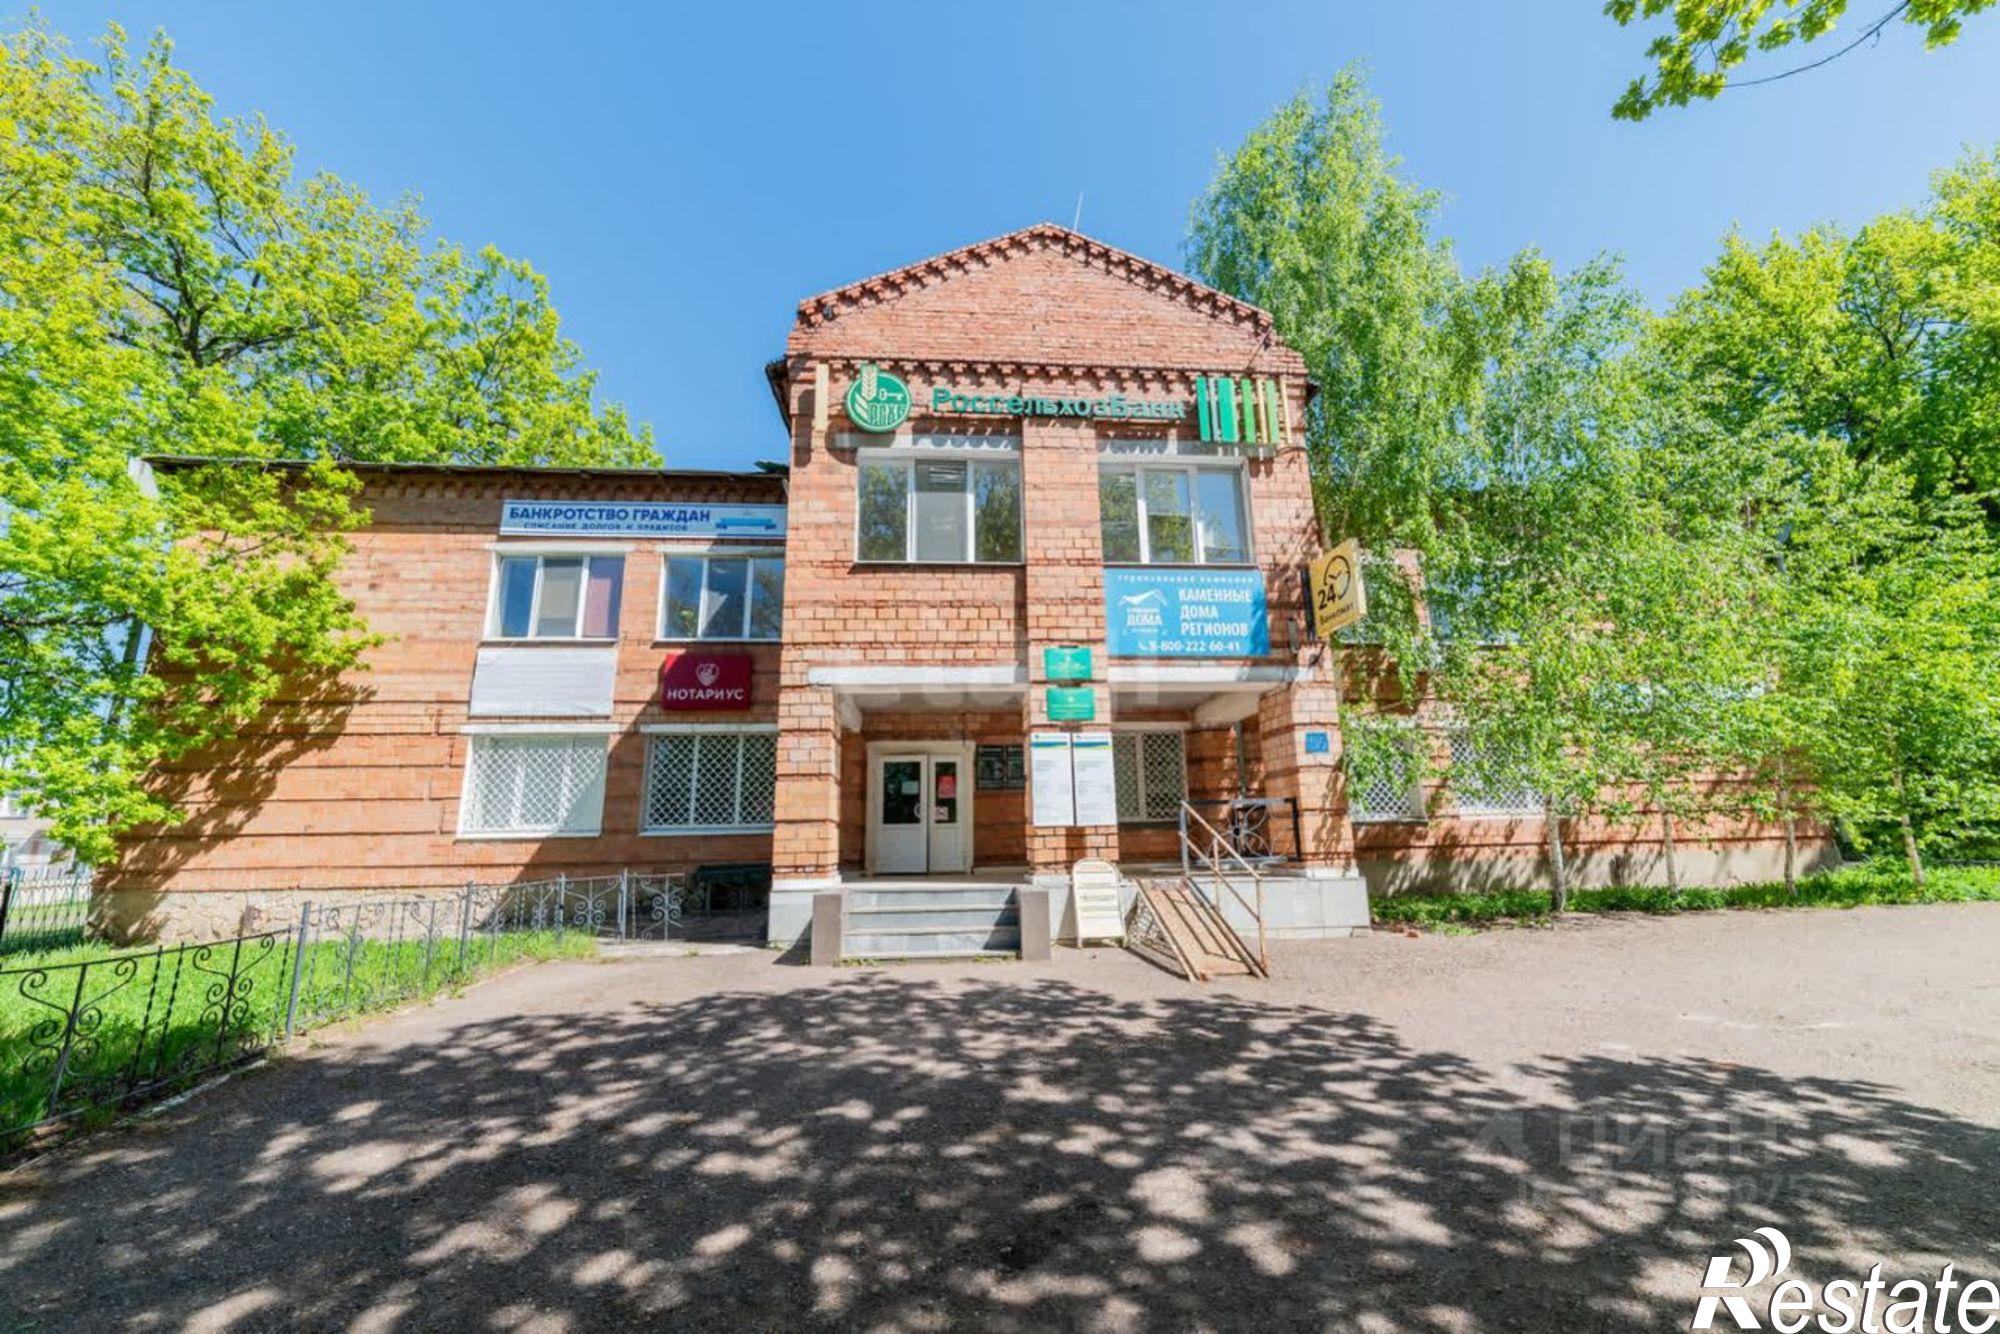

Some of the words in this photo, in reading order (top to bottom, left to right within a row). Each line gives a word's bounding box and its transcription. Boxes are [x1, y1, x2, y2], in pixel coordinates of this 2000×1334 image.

[509, 506, 628, 522] БАНКРОТСТВО
[632, 508, 711, 524] ГРАЖДАН
[582, 523, 621, 531] ДОЛГОВ
[1178, 587, 1253, 602] КАМЕННЫЕ
[1317, 583, 1336, 610] 24
[1180, 605, 1219, 620] ДОМА
[1181, 622, 1249, 637] РЕГИОНОВ
[666, 688, 744, 700] НОТАРИУС
